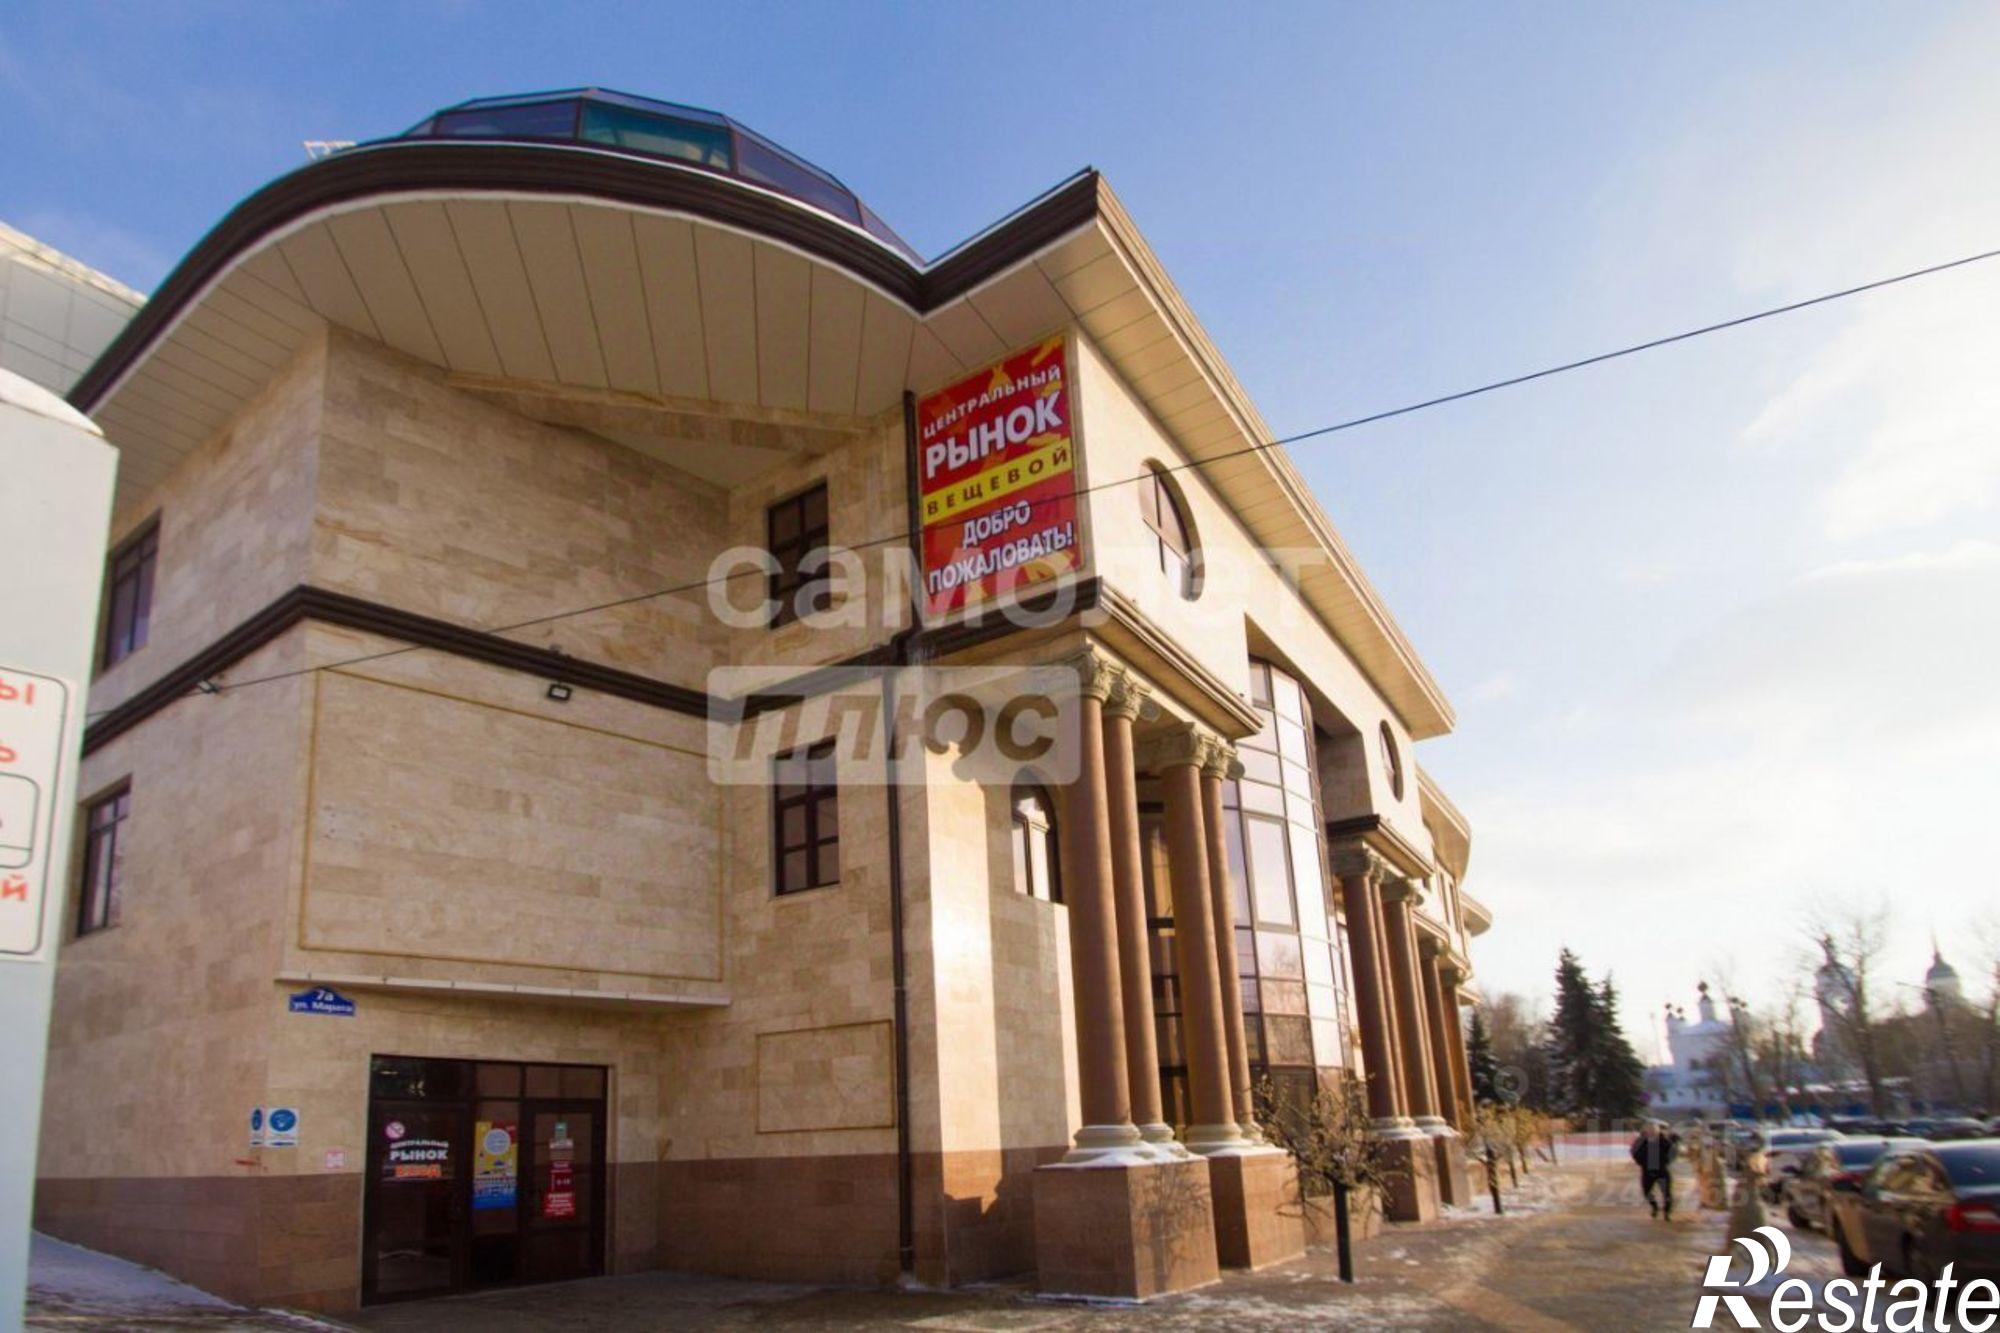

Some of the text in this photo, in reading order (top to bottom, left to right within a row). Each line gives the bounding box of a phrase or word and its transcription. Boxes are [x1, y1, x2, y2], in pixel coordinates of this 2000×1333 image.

[923, 365, 1062, 439] ЦЕНТРАЛЬНЫЙ
[925, 390, 1063, 479] РЫНОК
[926, 447, 1068, 516] ВЕЩЕВОЙ
[929, 521, 1075, 594] ПОЖАЛОВАТЬ!
[962, 500, 1031, 549] ДОБРО
[390, 1149, 449, 1160] РЫНОК
